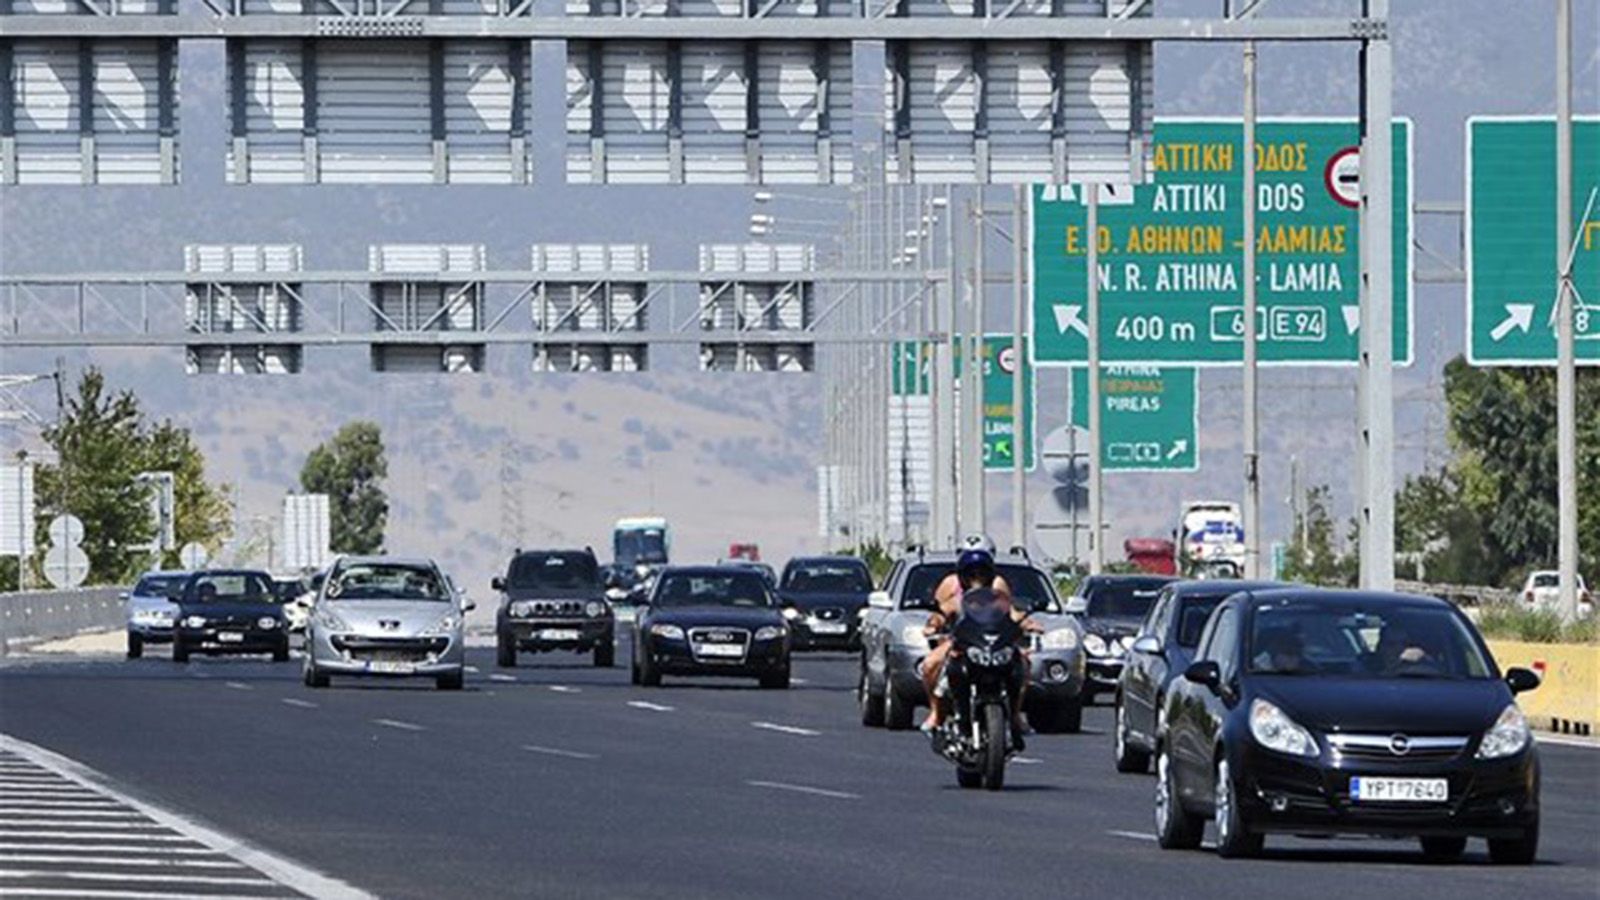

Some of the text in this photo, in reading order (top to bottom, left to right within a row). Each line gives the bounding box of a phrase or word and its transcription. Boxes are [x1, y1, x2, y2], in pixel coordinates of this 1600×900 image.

[1153, 143, 1233, 171] ΑΤΤΙΚΗ
[1152, 183, 1305, 212] ATTIKI DOS
[1127, 225, 1223, 254] ΑΘΗΝΩΝ
[1258, 225, 1346, 254] ΛΑΜΙΑΣ
[1155, 263, 1237, 291] ATHINA
[1270, 263, 1343, 291] LAMIA
[1115, 316, 1195, 340] 400 m
[1276, 313, 1321, 334] E 94
[1106, 396, 1161, 413] PIREAS
